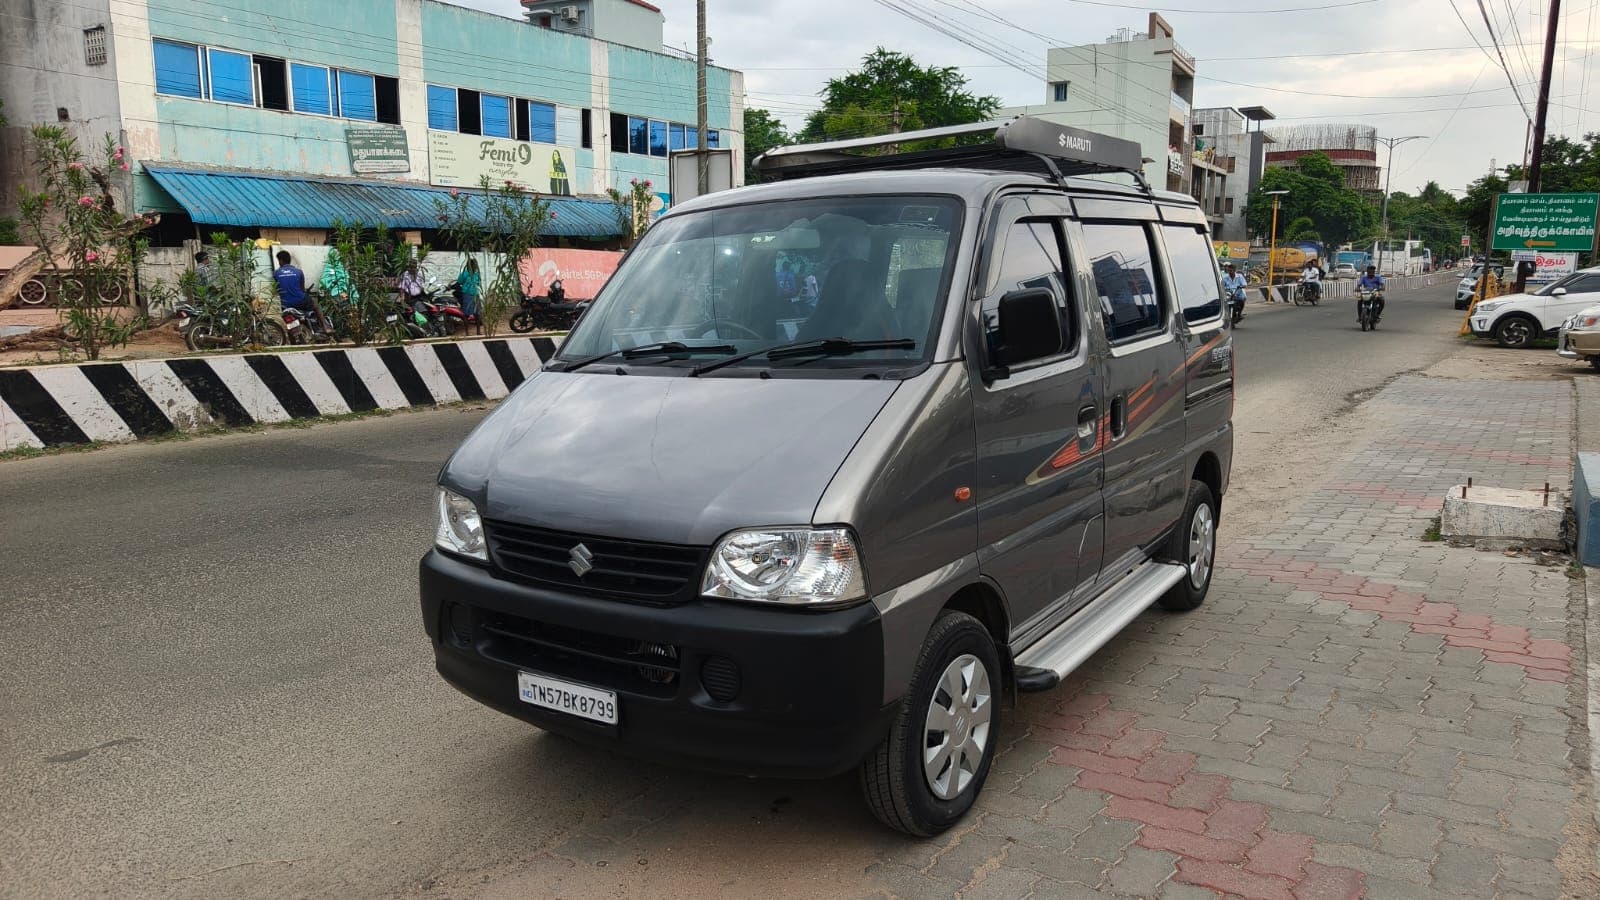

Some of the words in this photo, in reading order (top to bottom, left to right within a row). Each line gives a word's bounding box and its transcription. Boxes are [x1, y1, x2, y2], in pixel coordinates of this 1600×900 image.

[1066, 135, 1092, 153] MARUTI
[1497, 225, 1595, 238] அறிவுத்திருக்கோயில்
[561, 268, 583, 280] airtel
[530, 683, 614, 719] TN57BK8799
